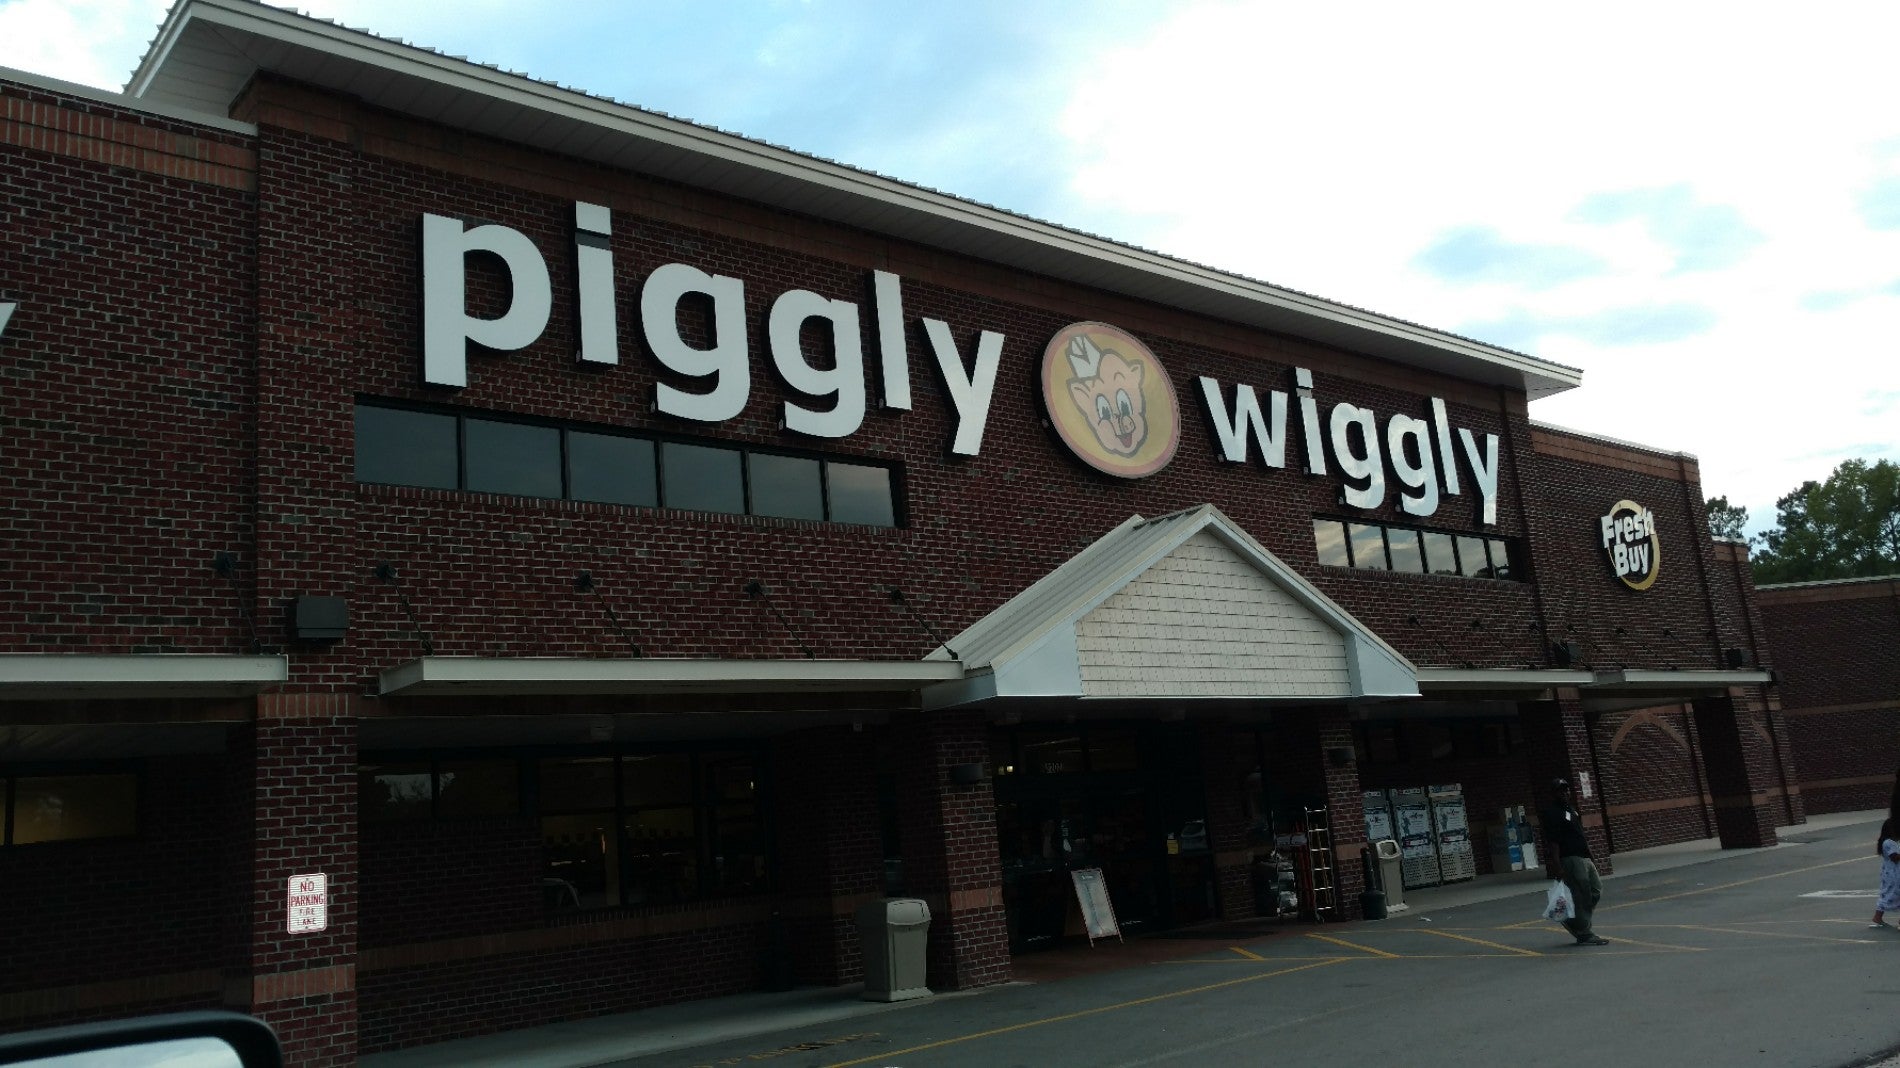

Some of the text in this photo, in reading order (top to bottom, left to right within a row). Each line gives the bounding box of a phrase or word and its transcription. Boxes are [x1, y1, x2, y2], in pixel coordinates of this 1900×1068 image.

[423, 200, 1499, 526] piggly wiggly
[1601, 506, 1656, 549] Fresh
[300, 880, 315, 892] NO
[290, 894, 324, 907] PARKING
[299, 907, 315, 916] FIRE
